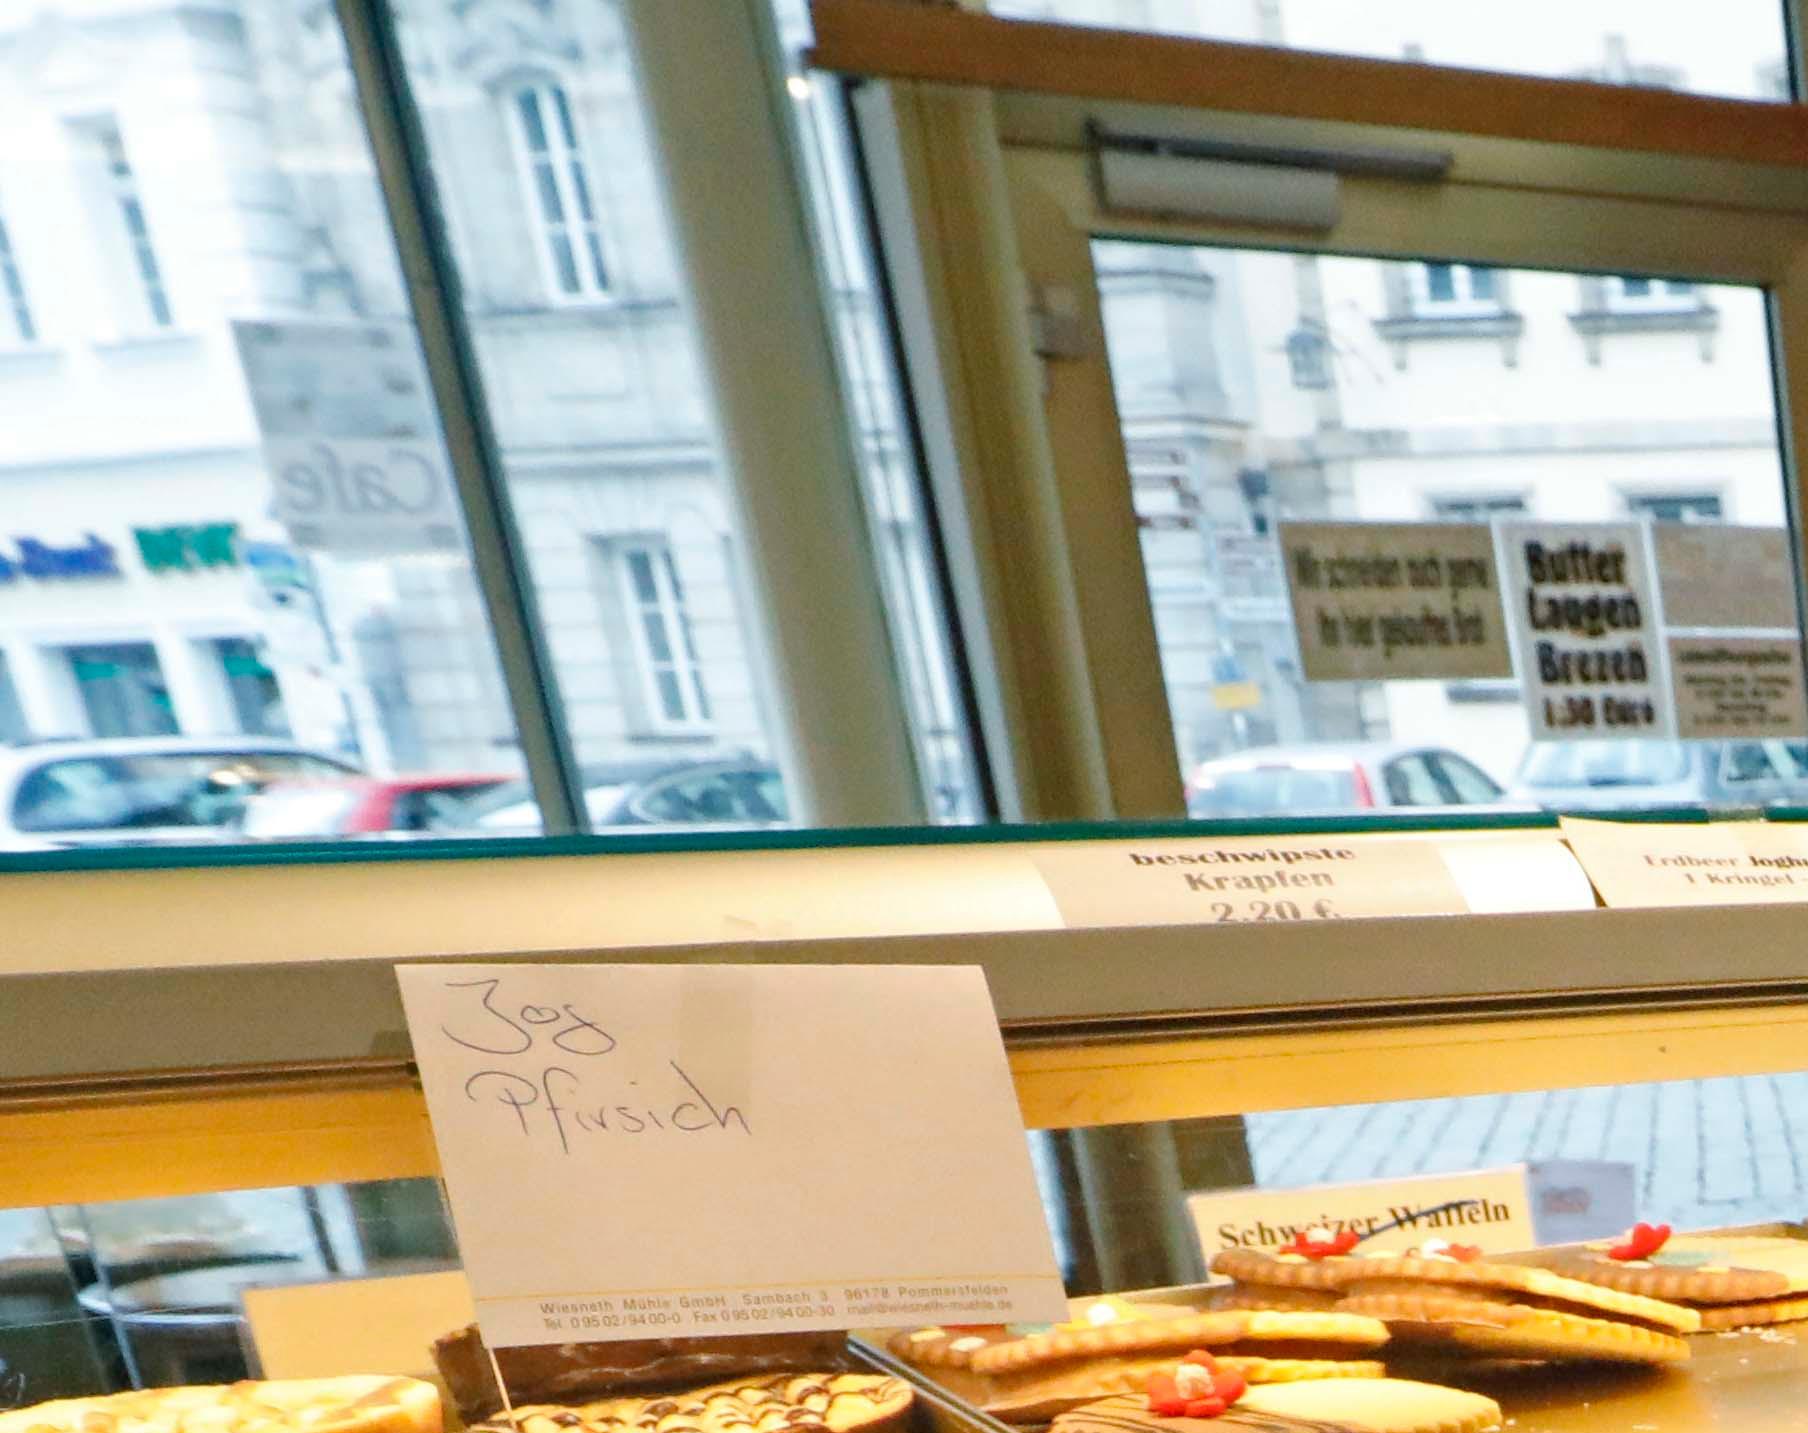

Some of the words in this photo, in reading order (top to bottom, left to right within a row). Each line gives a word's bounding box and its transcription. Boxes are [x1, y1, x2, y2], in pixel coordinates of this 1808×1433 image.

[1524, 539, 1627, 584] Butter
[1526, 584, 1643, 637] Laugen
[1536, 639, 1649, 685] Brezen
[1129, 847, 1356, 869] beschwipste
[1183, 868, 1333, 894] Krapfen
[1388, 1198, 1511, 1231] Waffeln
[540, 1301, 614, 1314] Wiesneth
[623, 1298, 671, 1311] Mühle
[679, 1294, 727, 1309] GmbH
[742, 1291, 811, 1306] Sambach
[897, 1284, 1009, 1298] Pommersfelden
